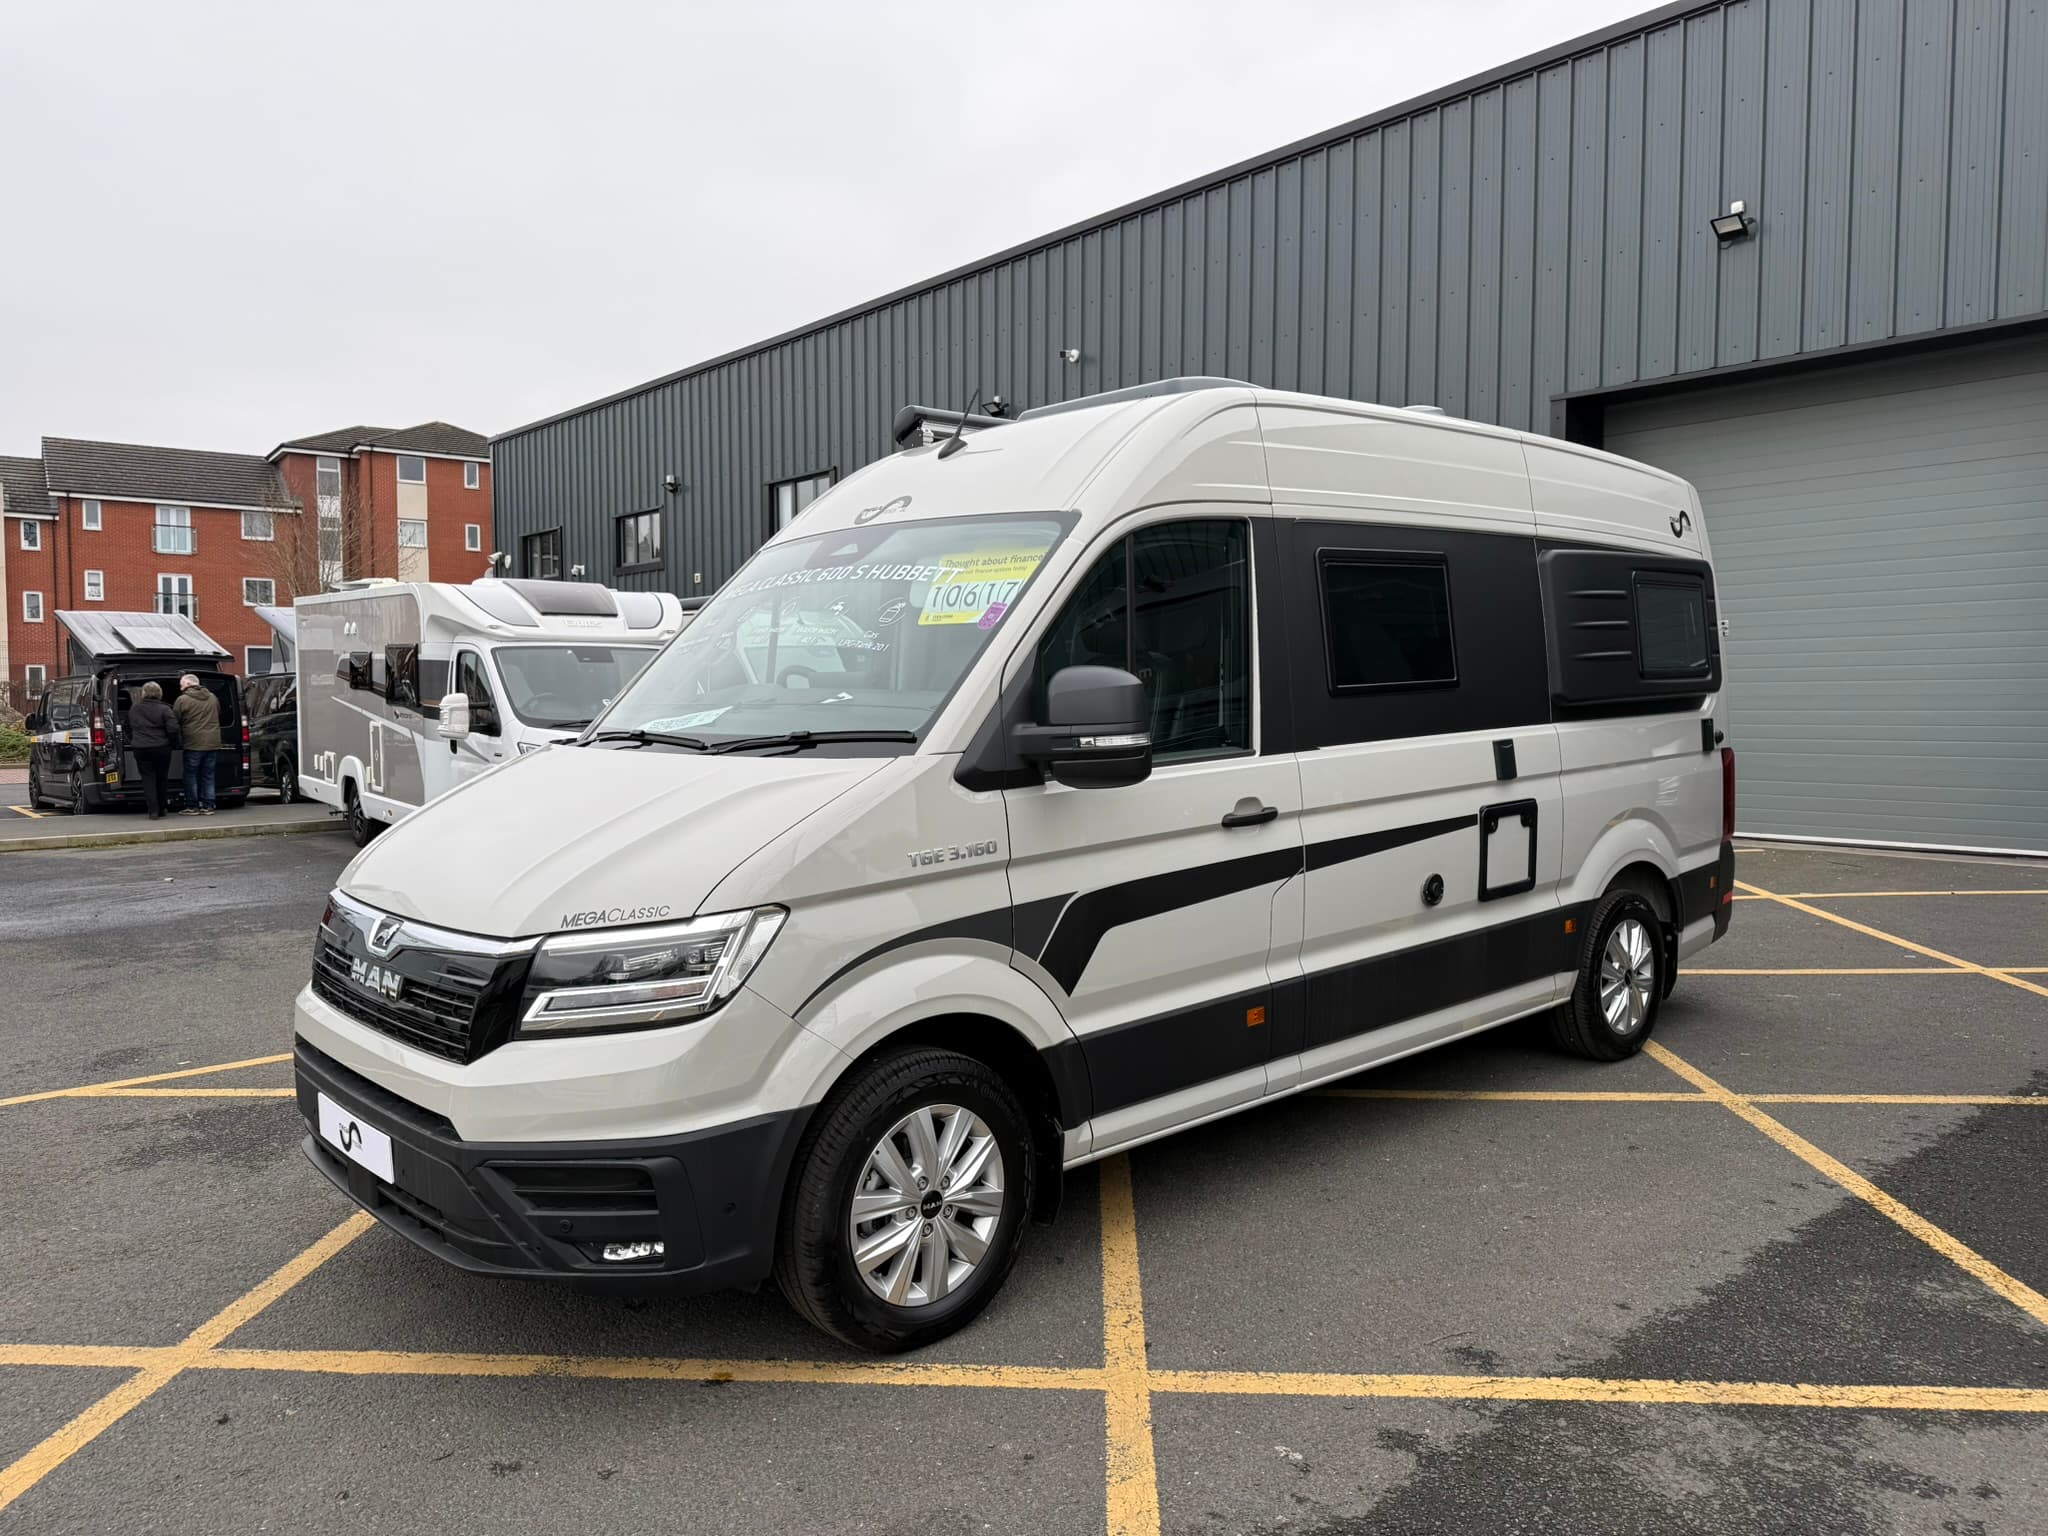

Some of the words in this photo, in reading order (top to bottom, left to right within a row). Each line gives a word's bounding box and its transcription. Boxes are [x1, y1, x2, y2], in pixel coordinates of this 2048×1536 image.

[944, 558, 979, 570] Thought
[982, 556, 1008, 566] about
[758, 568, 818, 590] CLASSIC
[816, 567, 853, 582] 600
[851, 565, 870, 579] S
[865, 564, 965, 584] HUBBETT
[931, 579, 1019, 608] 10617
[907, 847, 945, 868] TGE
[946, 839, 998, 861] 3.160
[560, 904, 671, 929] MEGACLASSIC
[350, 957, 401, 1001] MAN
